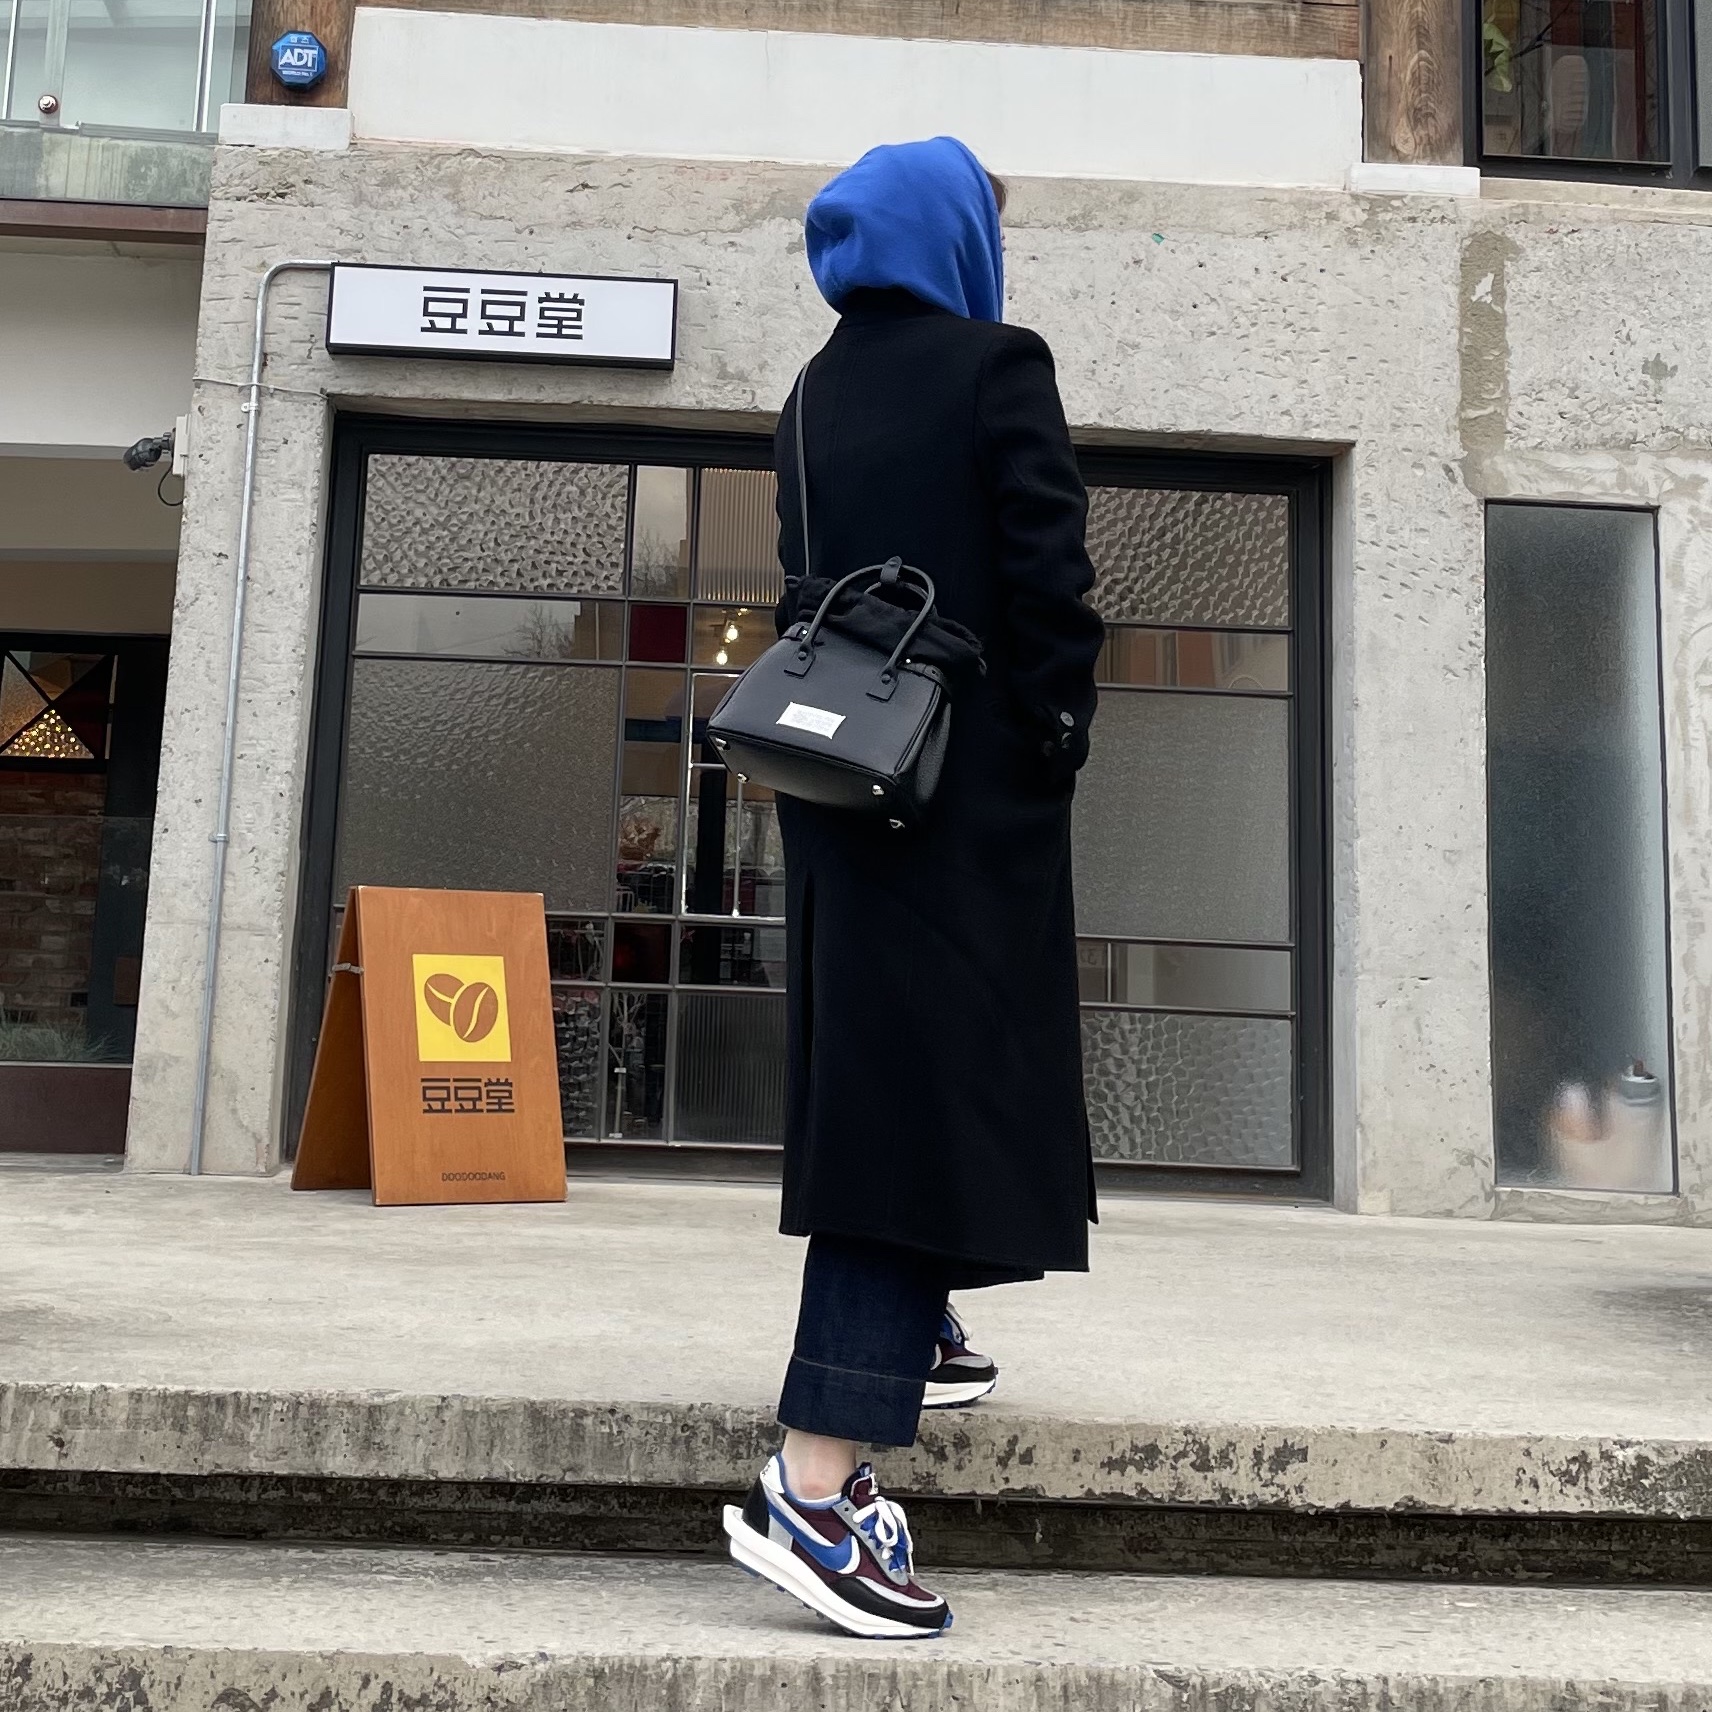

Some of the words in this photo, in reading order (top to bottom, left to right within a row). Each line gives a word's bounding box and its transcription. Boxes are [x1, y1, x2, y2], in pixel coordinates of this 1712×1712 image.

[279, 48, 318, 67] ADT
[420, 285, 585, 340] 豆豆堂
[420, 1077, 515, 1114] 豆豆堂
[441, 1171, 506, 1182] DOODOODANG
